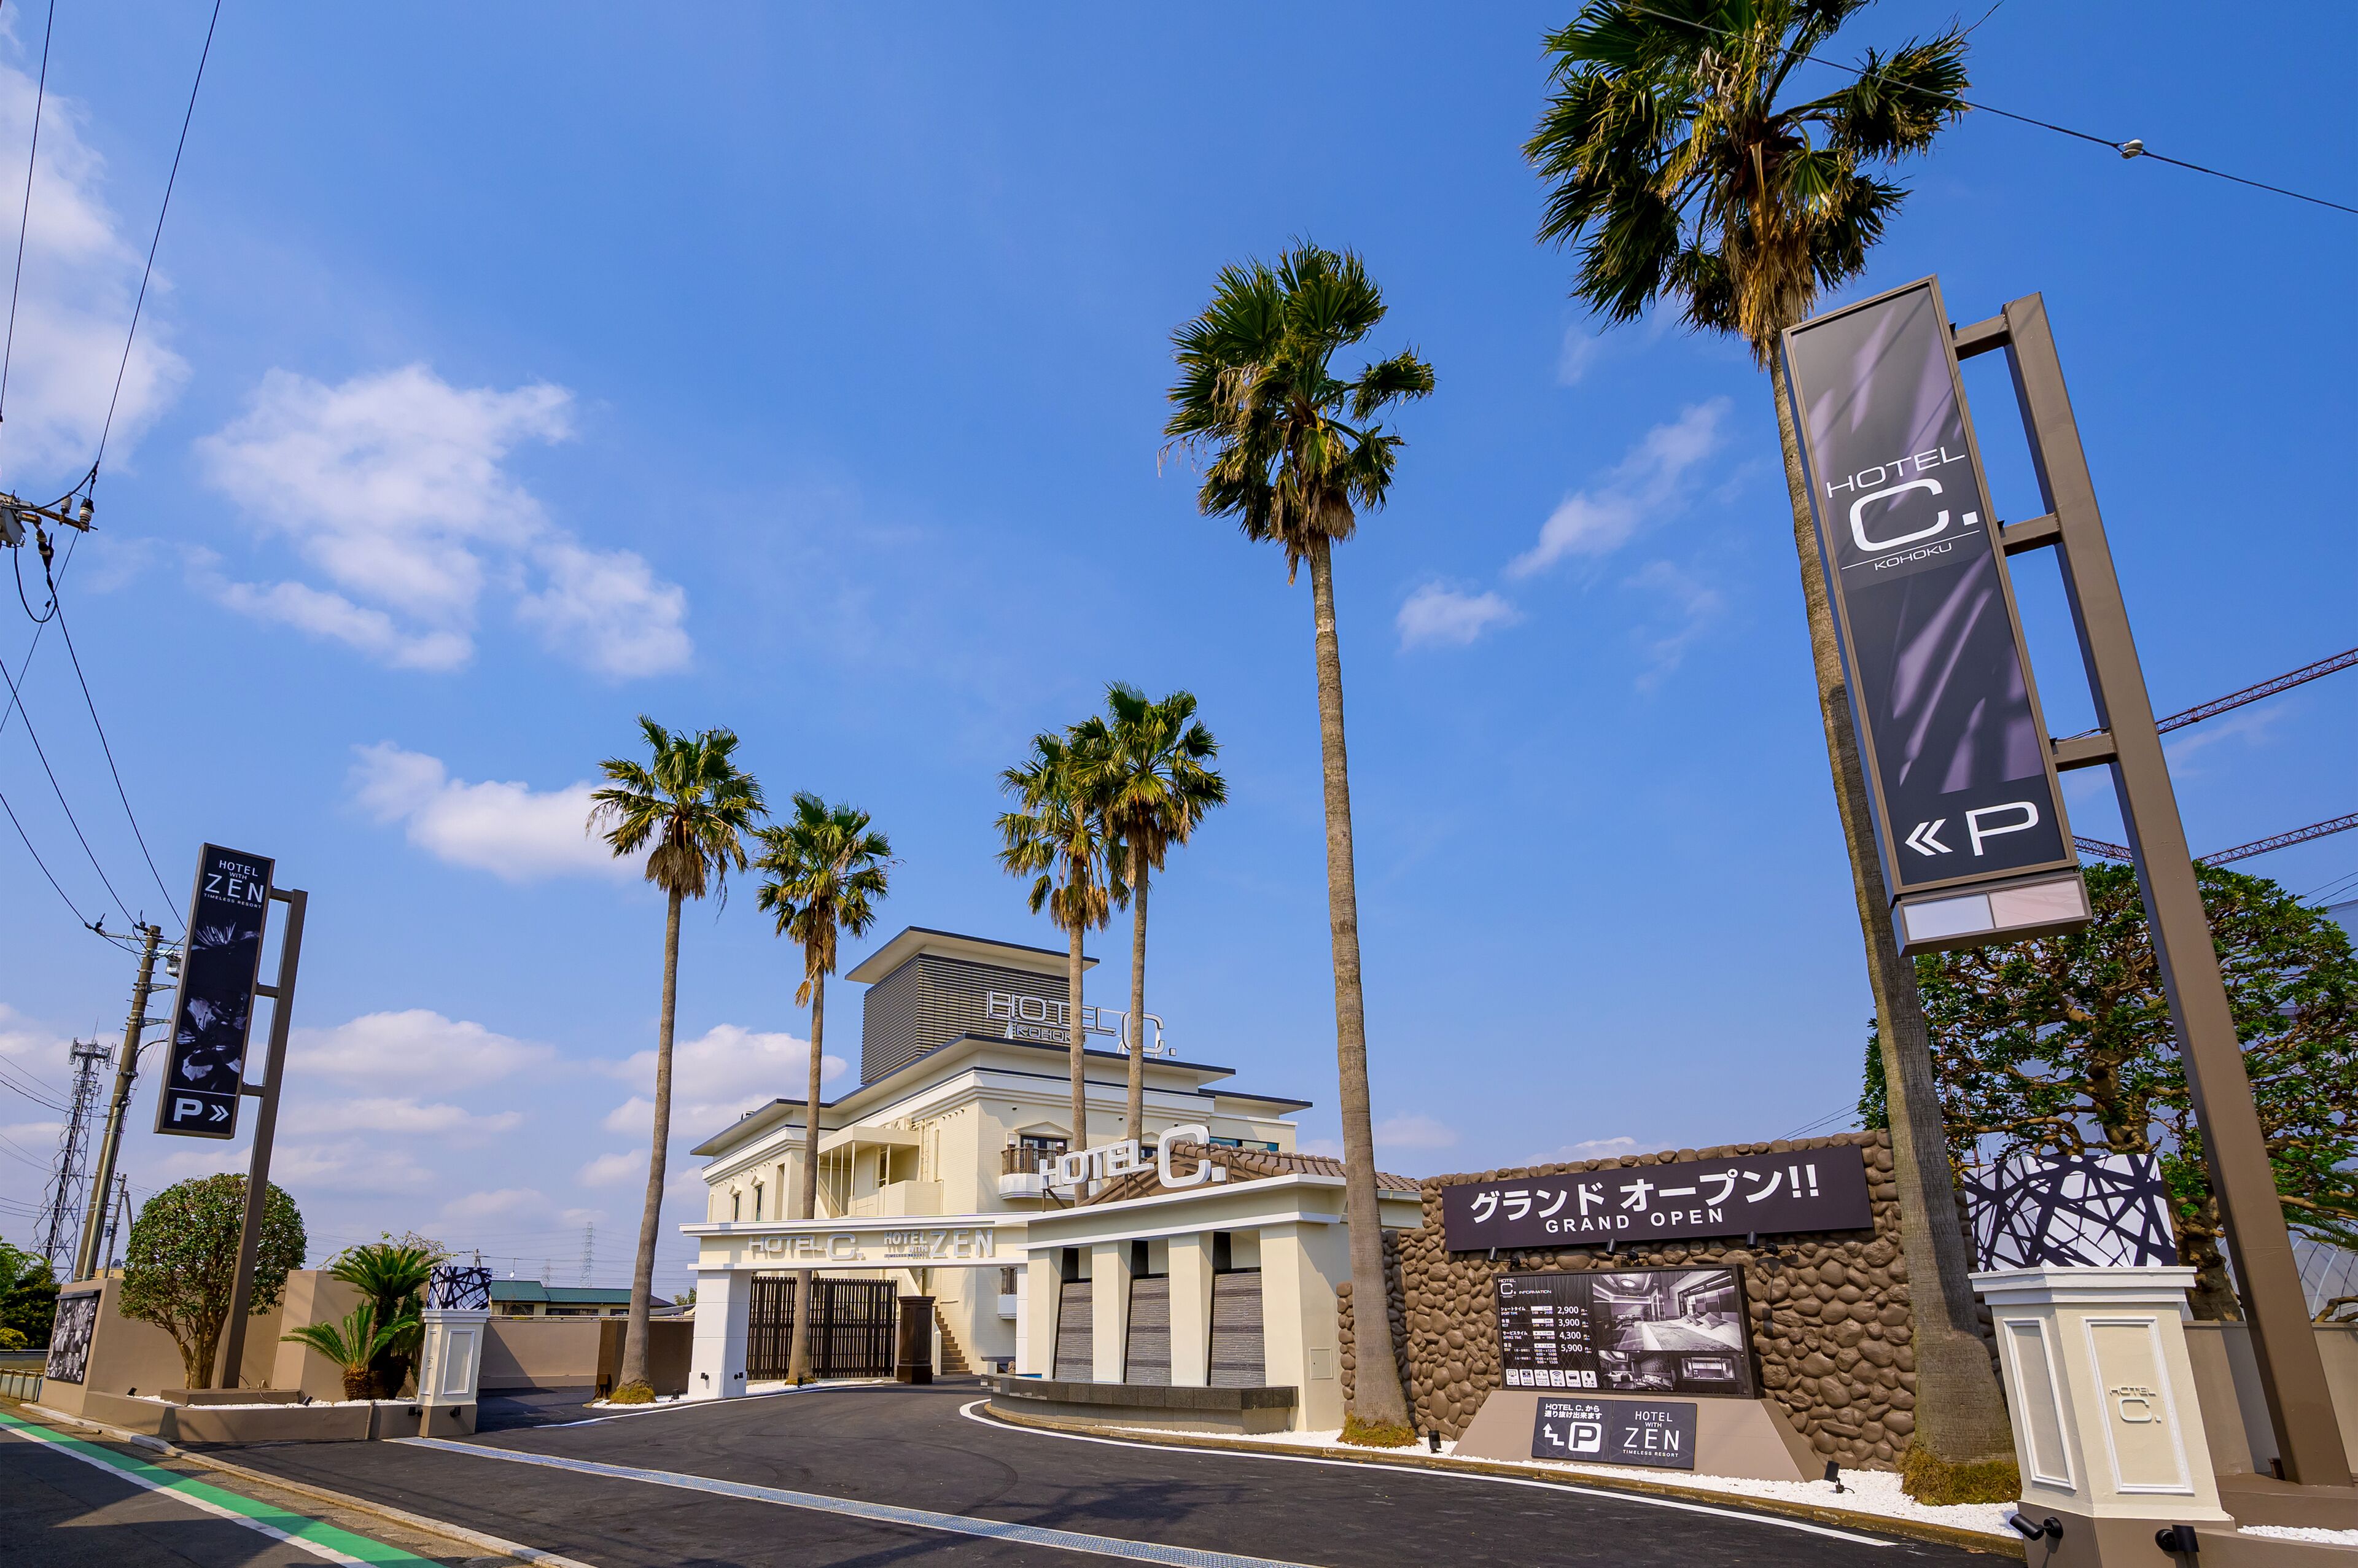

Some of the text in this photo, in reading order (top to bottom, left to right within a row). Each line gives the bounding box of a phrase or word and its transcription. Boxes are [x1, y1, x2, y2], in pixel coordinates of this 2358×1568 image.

[1826, 446, 1965, 498] HOTEL
[1850, 478, 1979, 551] C.
[1874, 543, 1952, 570] KOHOKU
[1966, 801, 2039, 856] P
[219, 860, 258, 877] HOTEL
[205, 873, 264, 902] ZEN
[204, 893, 262, 909] TIMELESS RESORT
[174, 1097, 203, 1122] P
[1039, 1124, 1226, 1189] HOTEL C.
[1470, 1182, 1605, 1223] グランド
[1546, 1208, 1722, 1233] GRAND OPEN
[748, 1235, 823, 1252] HOTEL
[884, 1230, 927, 1245] HOTEL
[930, 1229, 993, 1257] ZEN
[1557, 1306, 1579, 1315] 2,900
[1558, 1319, 1579, 1327] 3,900
[1559, 1332, 1581, 1340] 4,300
[1561, 1344, 1582, 1353] 5,900
[2108, 1386, 2156, 1396] HOTEL
[1635, 1411, 1673, 1422] HOTEL
[1573, 1424, 1597, 1448] P
[1624, 1427, 1679, 1451] ZEN
